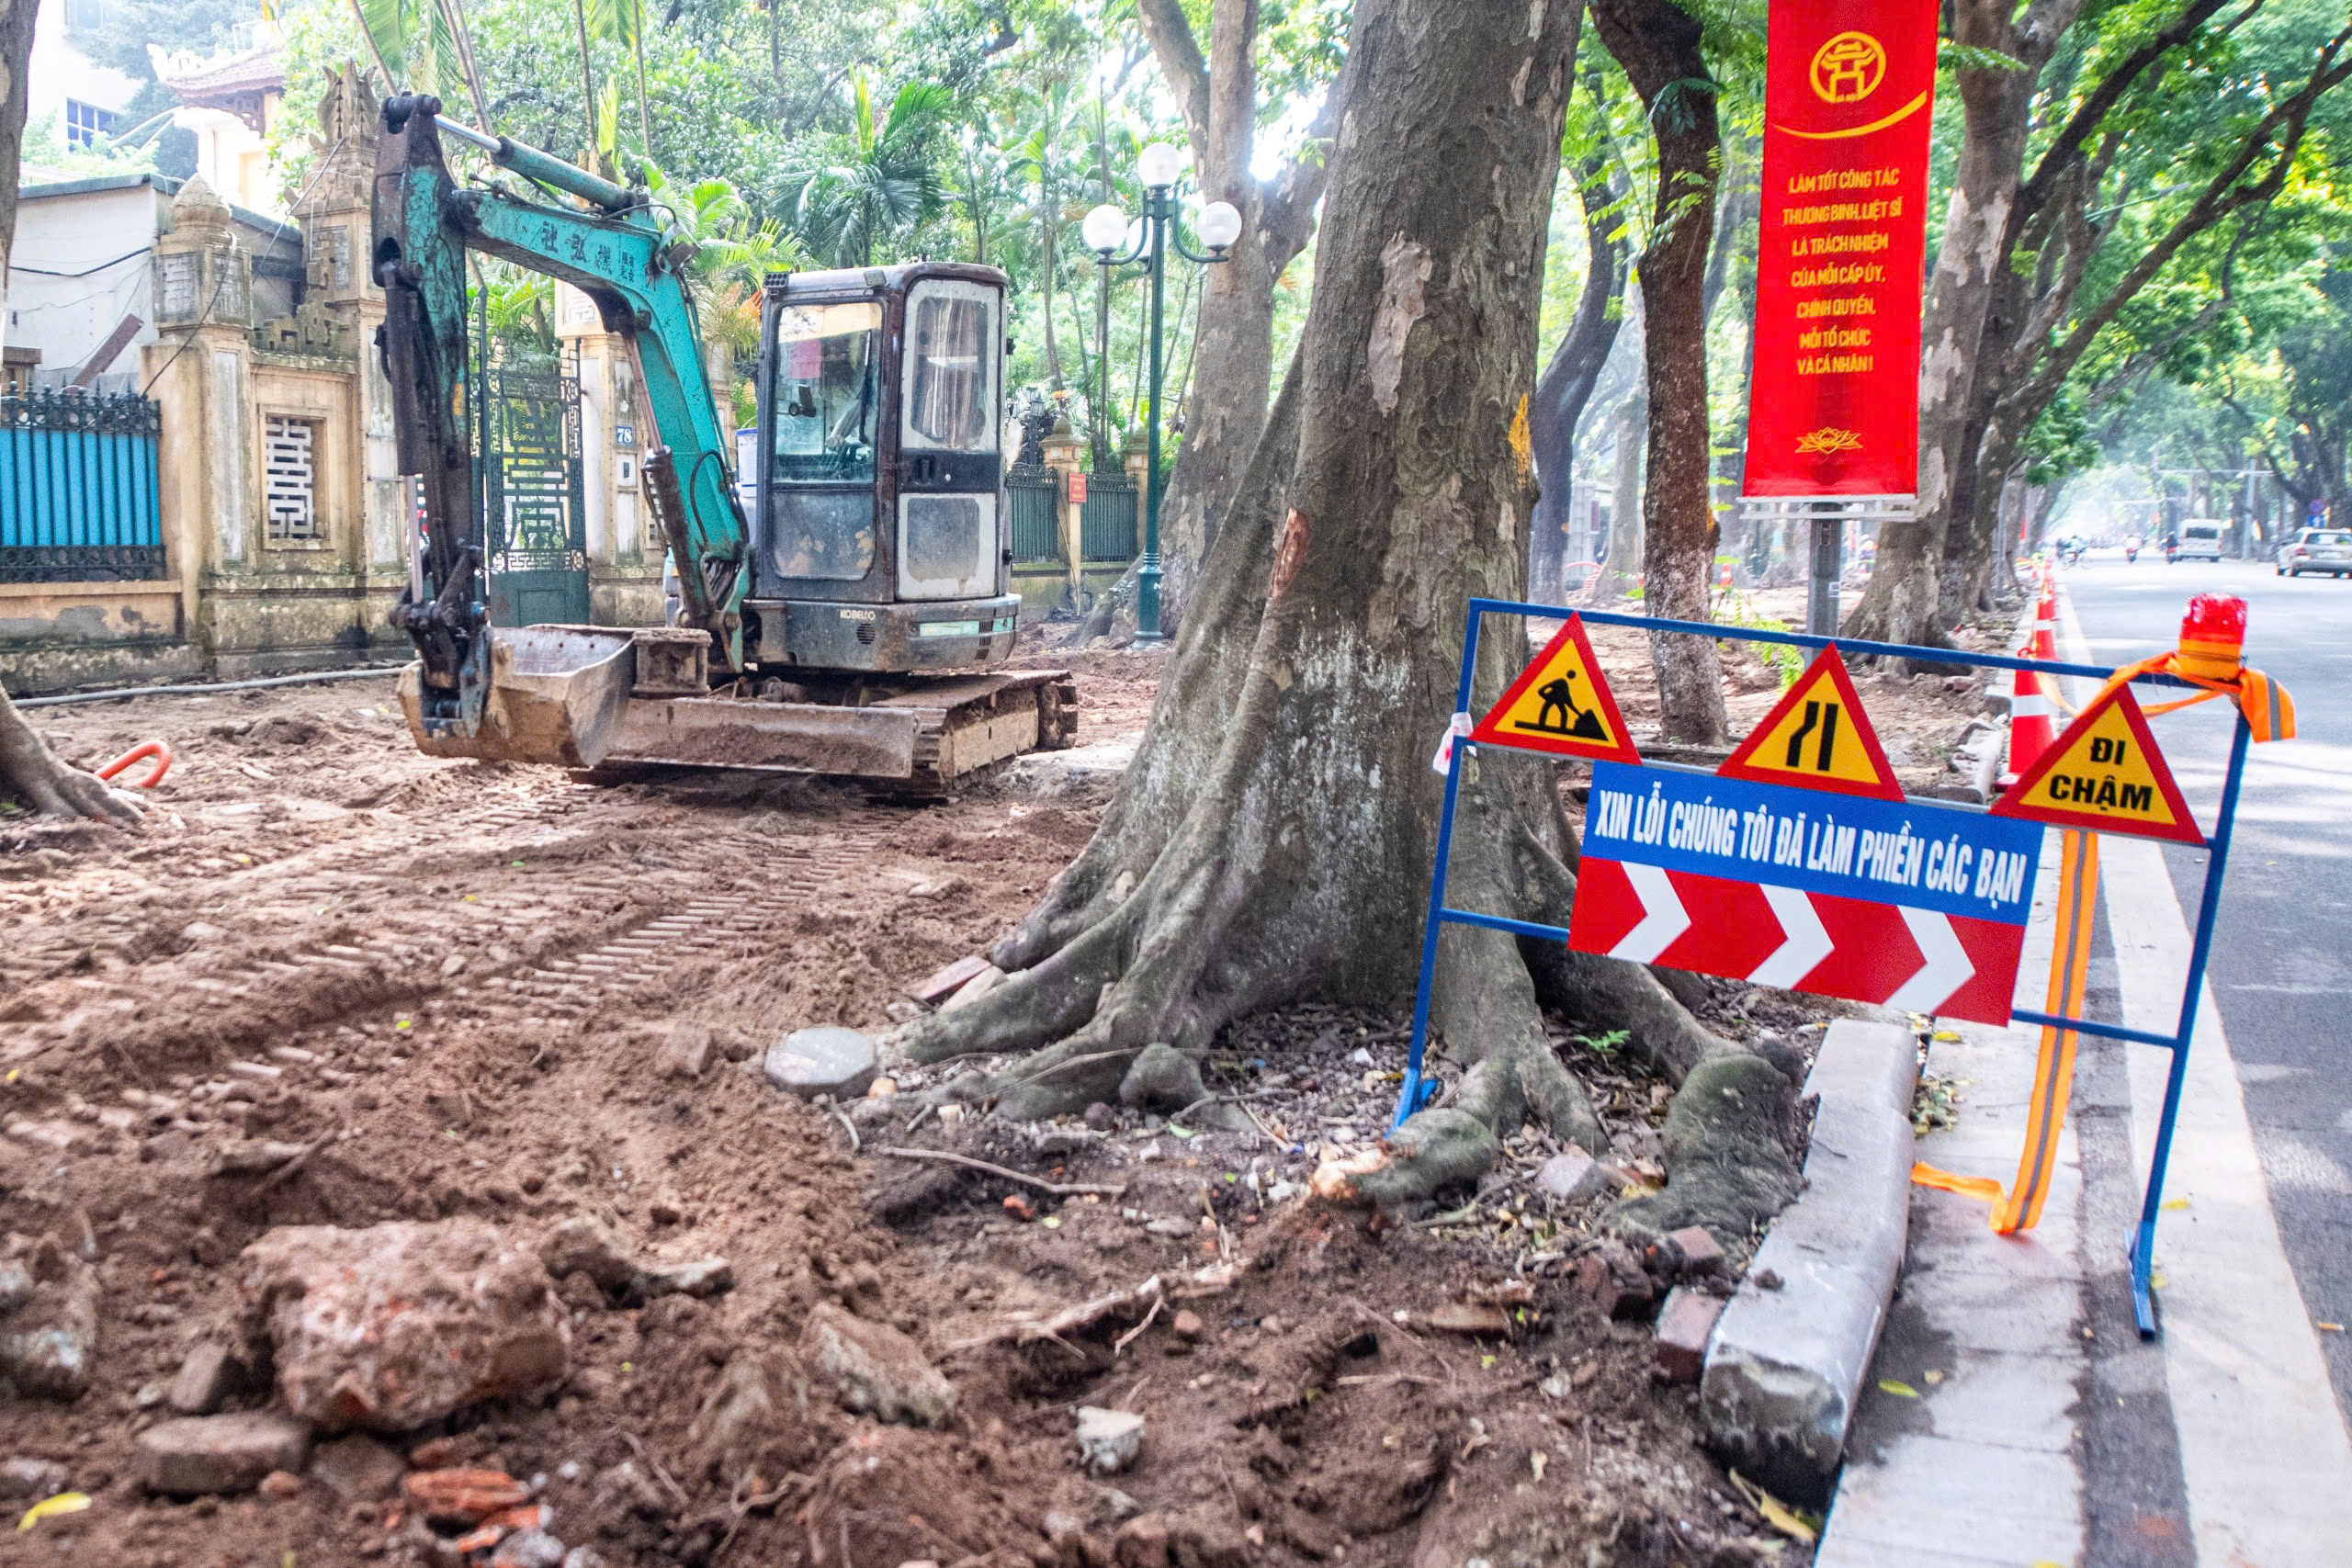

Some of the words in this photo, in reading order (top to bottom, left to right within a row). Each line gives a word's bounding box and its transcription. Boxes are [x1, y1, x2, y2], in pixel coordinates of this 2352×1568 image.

[1788, 173, 1815, 194] LÀM
[1817, 169, 1838, 191] TỐT
[1874, 165, 1900, 186] TÁC
[1792, 236, 1808, 256] LÀ
[1810, 232, 1849, 255] TRÁCH
[1797, 355, 1815, 375] VÀ
[1815, 353, 1831, 374] CÁ
[617, 427, 632, 444] 78
[840, 608, 876, 621] KOBELCO
[2090, 737, 2127, 766] ĐI
[2049, 774, 2153, 812] CHẬM
[1594, 790, 1633, 840] XIN
[1633, 781, 1668, 845] LỖI
[1668, 795, 1738, 857] CHÚNG
[1740, 804, 1775, 863] TÔI
[1774, 812, 1806, 868] ĐÃ
[1806, 814, 1857, 875] LÀM
[1856, 820, 1926, 887] PHIỀN
[1925, 833, 1973, 895] CÁC
[1974, 848, 2027, 909] BẠN
